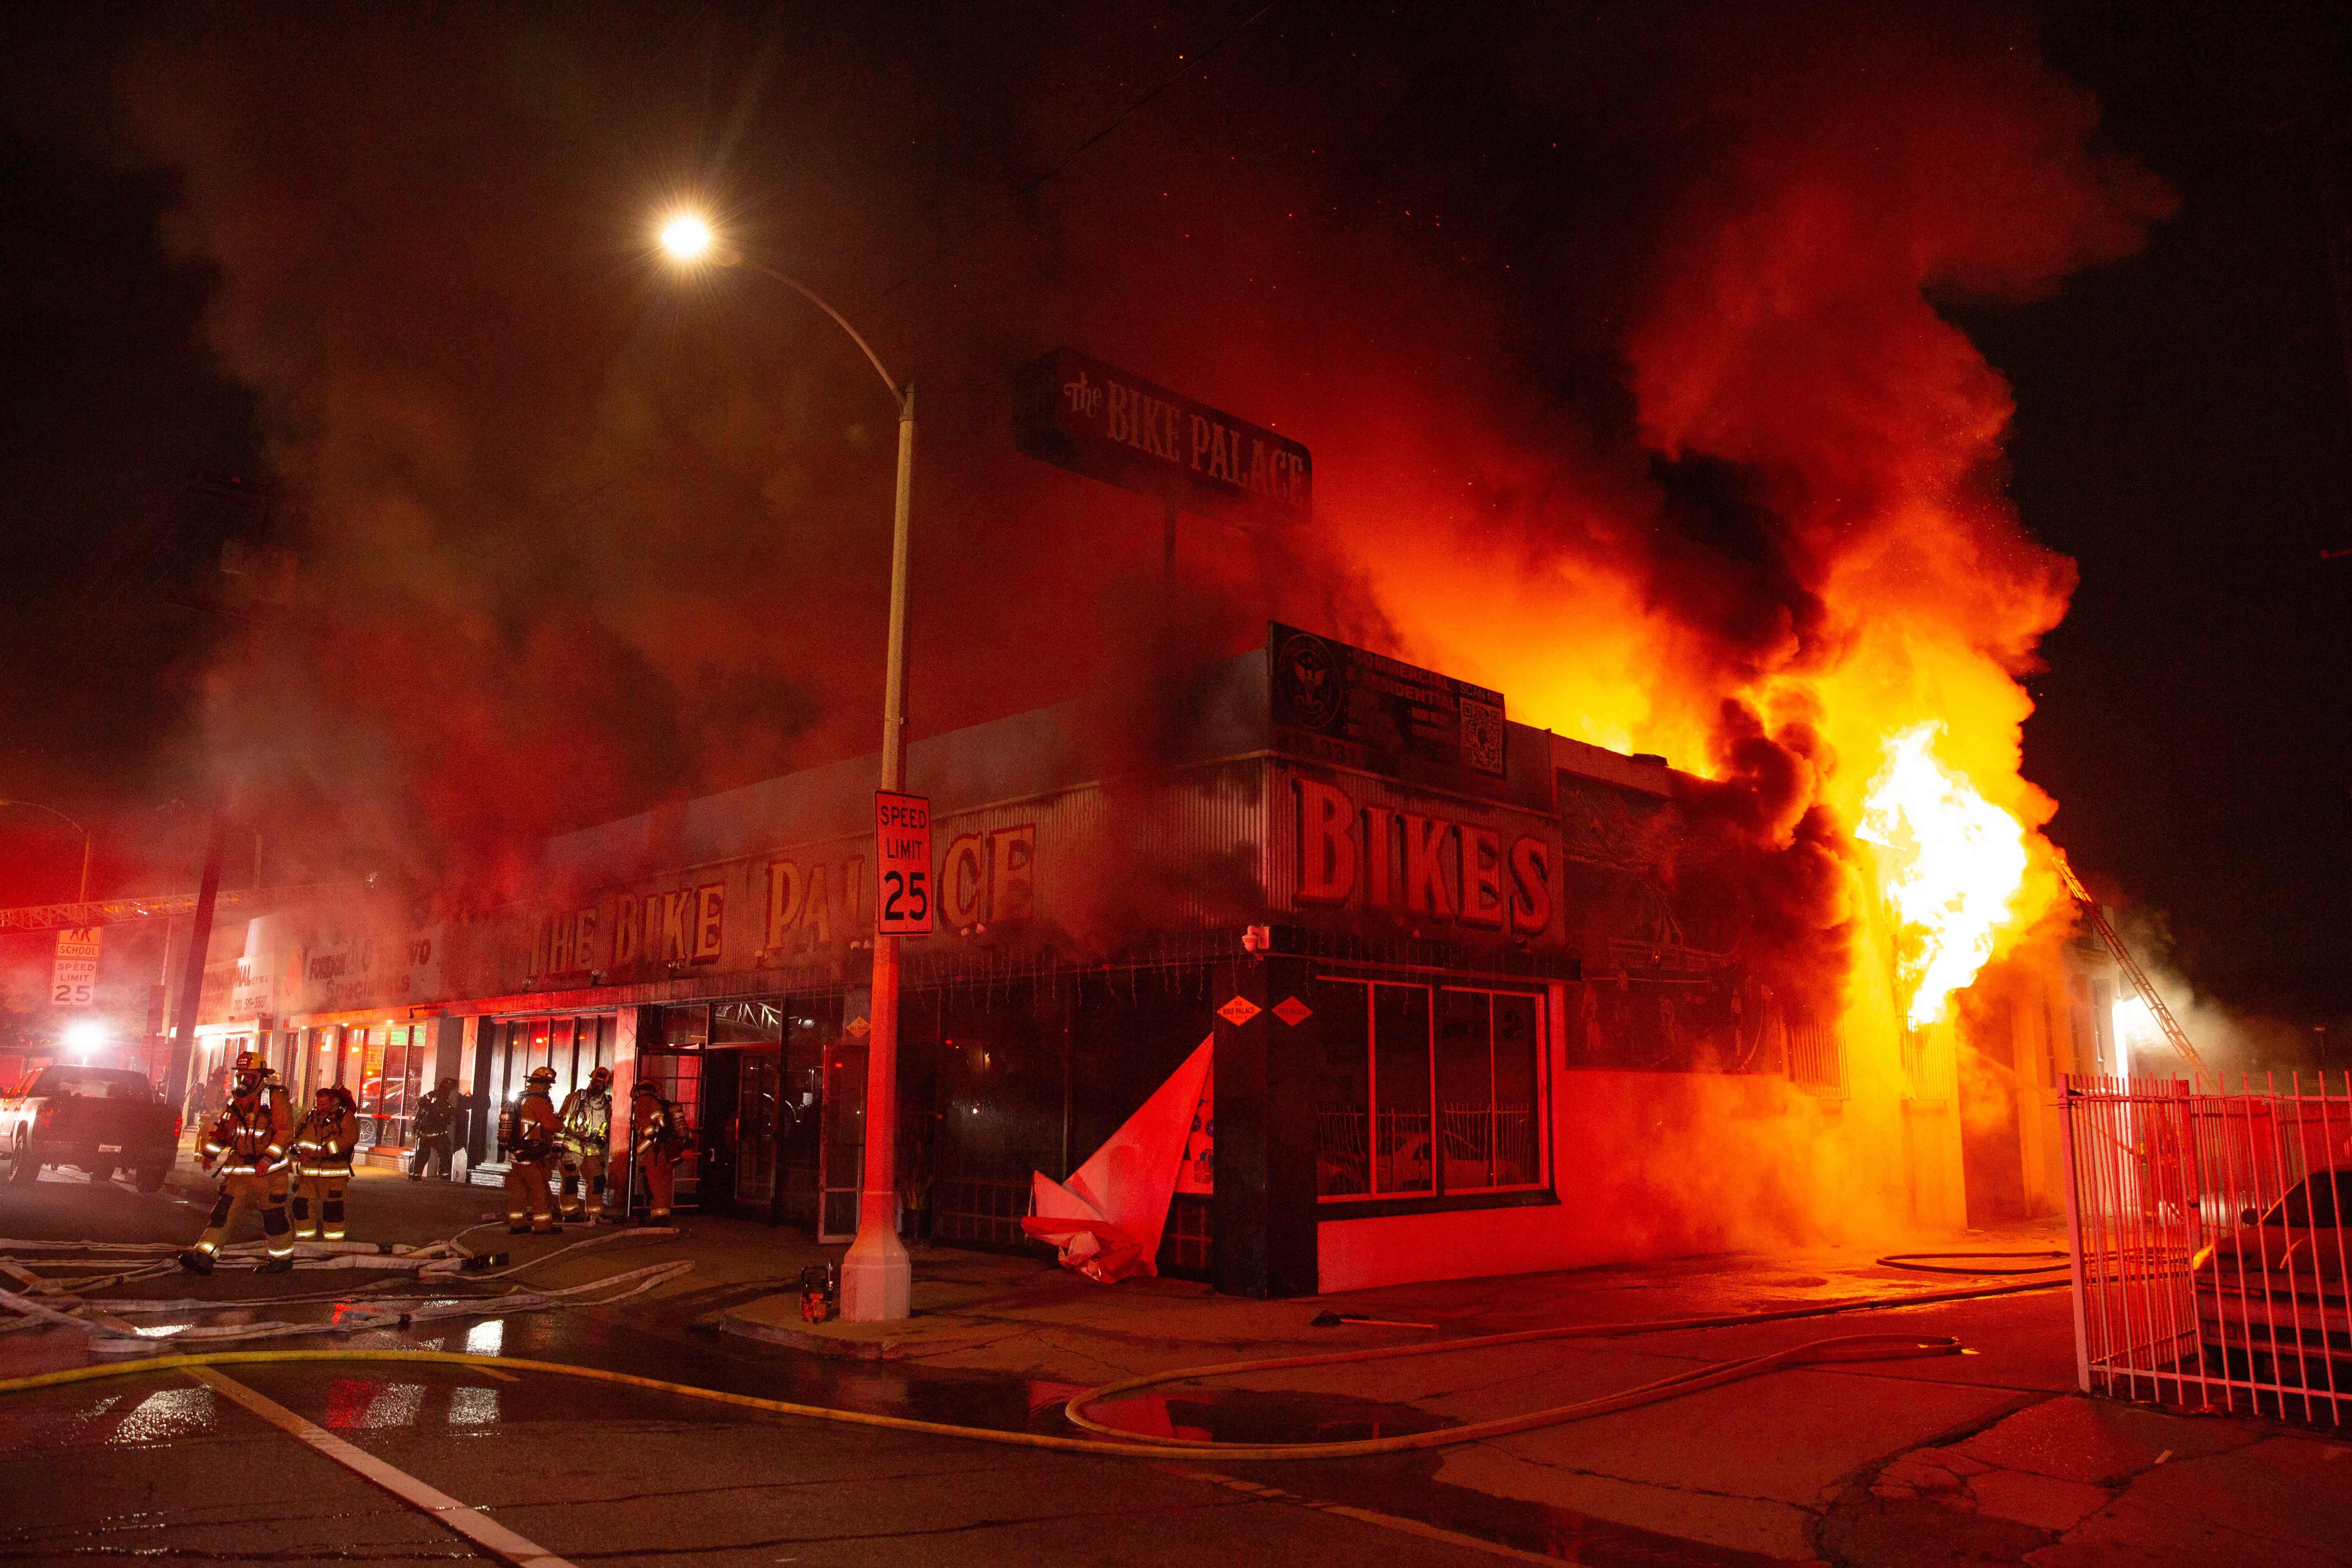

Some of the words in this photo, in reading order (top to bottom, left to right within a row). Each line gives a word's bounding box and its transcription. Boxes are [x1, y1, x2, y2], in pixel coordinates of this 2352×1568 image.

[1107, 379, 1180, 463] BIKE
[1190, 412, 1305, 509] PALACE
[1353, 648, 1452, 691] COMMERCIAL
[1459, 682, 1486, 701] SCAN
[1487, 690, 1503, 706] ME
[880, 805, 927, 829] SPEED
[886, 838, 922, 860] LIMIT
[1292, 777, 1551, 936] BIKES
[612, 881, 726, 966] BIKE
[766, 822, 1036, 951] PALCE
[884, 871, 927, 921] 25
[60, 945, 97, 955] SCHOOL
[60, 973, 89, 982] LIMIT
[54, 984, 91, 1002] 25
